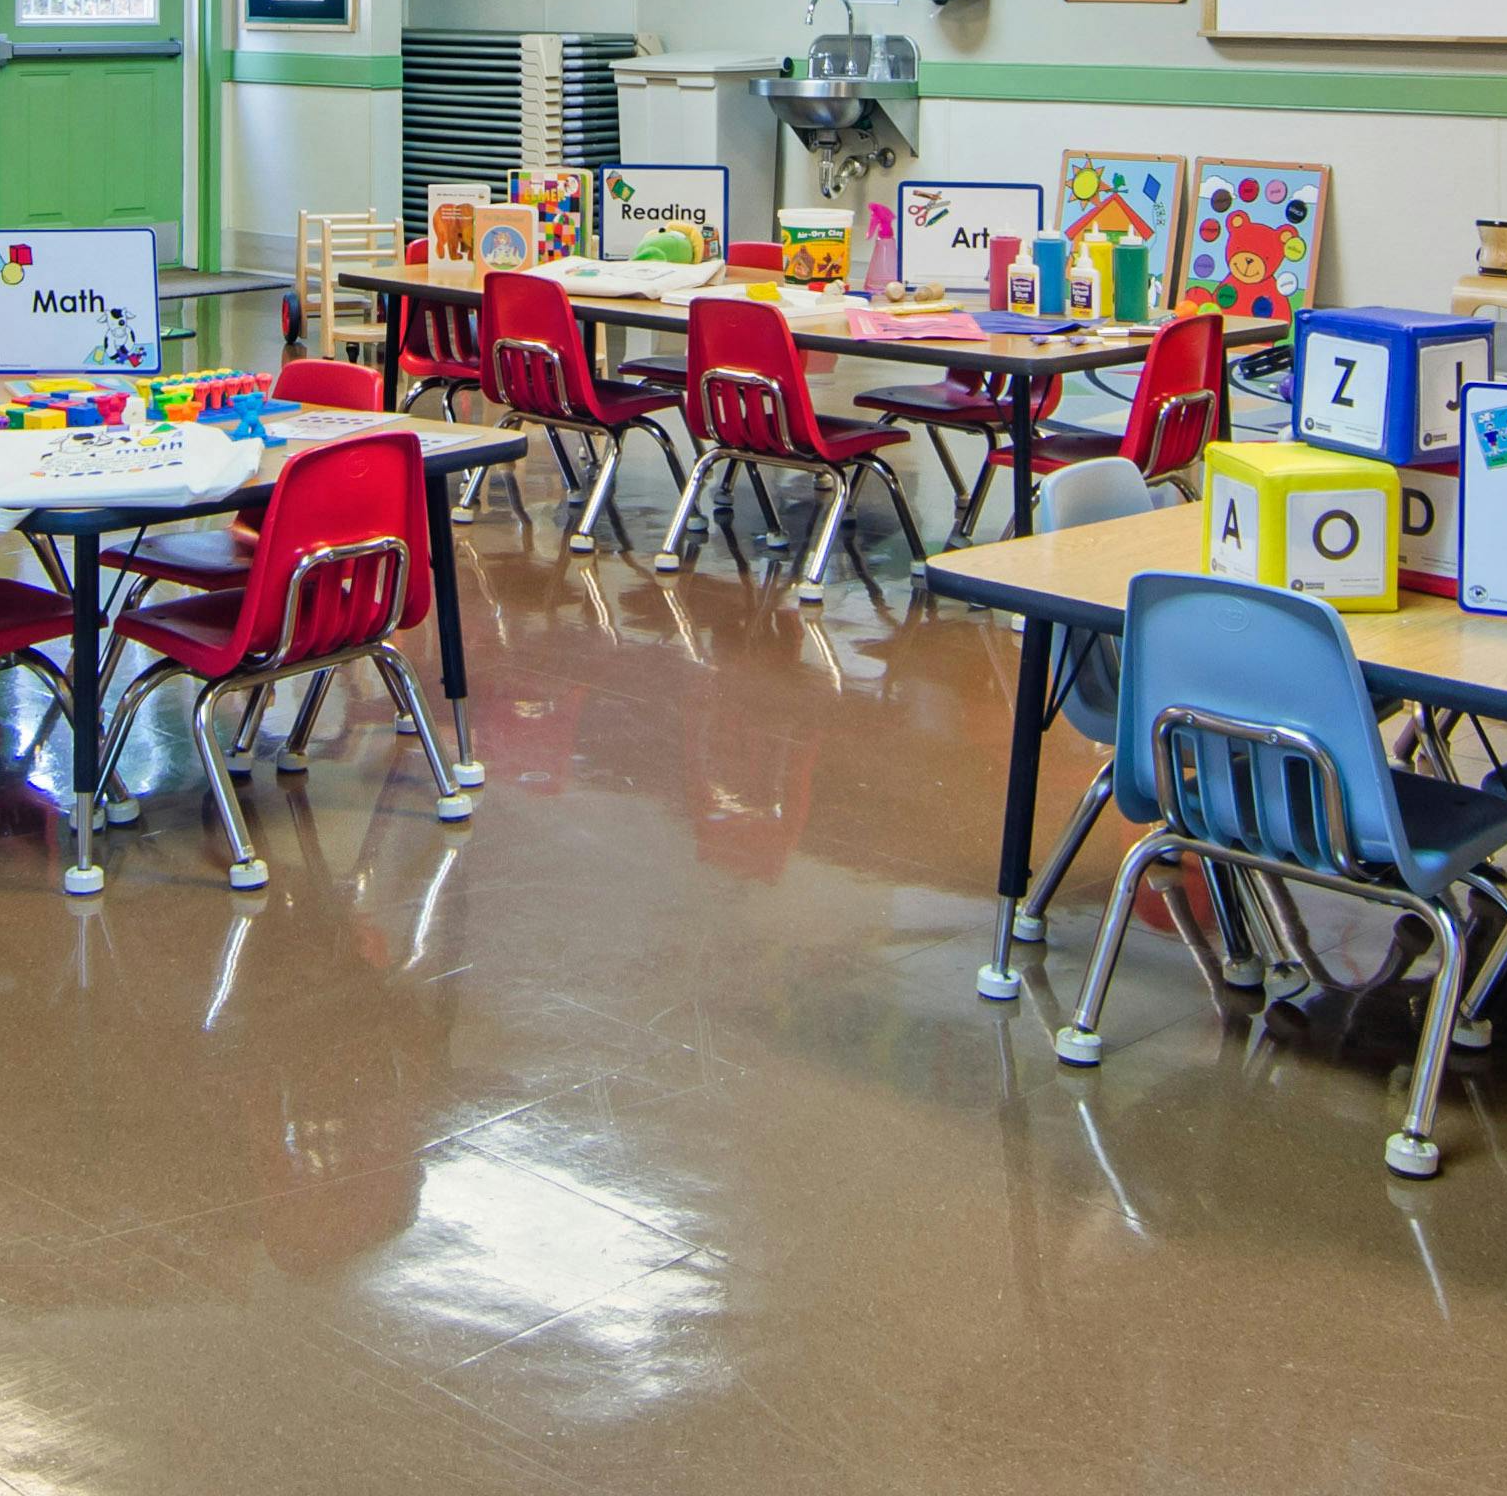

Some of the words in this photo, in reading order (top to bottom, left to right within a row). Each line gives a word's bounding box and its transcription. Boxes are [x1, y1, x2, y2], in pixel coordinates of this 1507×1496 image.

[621, 203, 706, 225] Reading
[951, 226, 990, 249] Art
[33, 289, 105, 313] Math
[1331, 357, 1358, 408] Z
[1445, 361, 1463, 412] J
[115, 440, 183, 455] math
[1222, 497, 1242, 550] A
[1312, 509, 1360, 561] O
[1402, 487, 1435, 537] D
